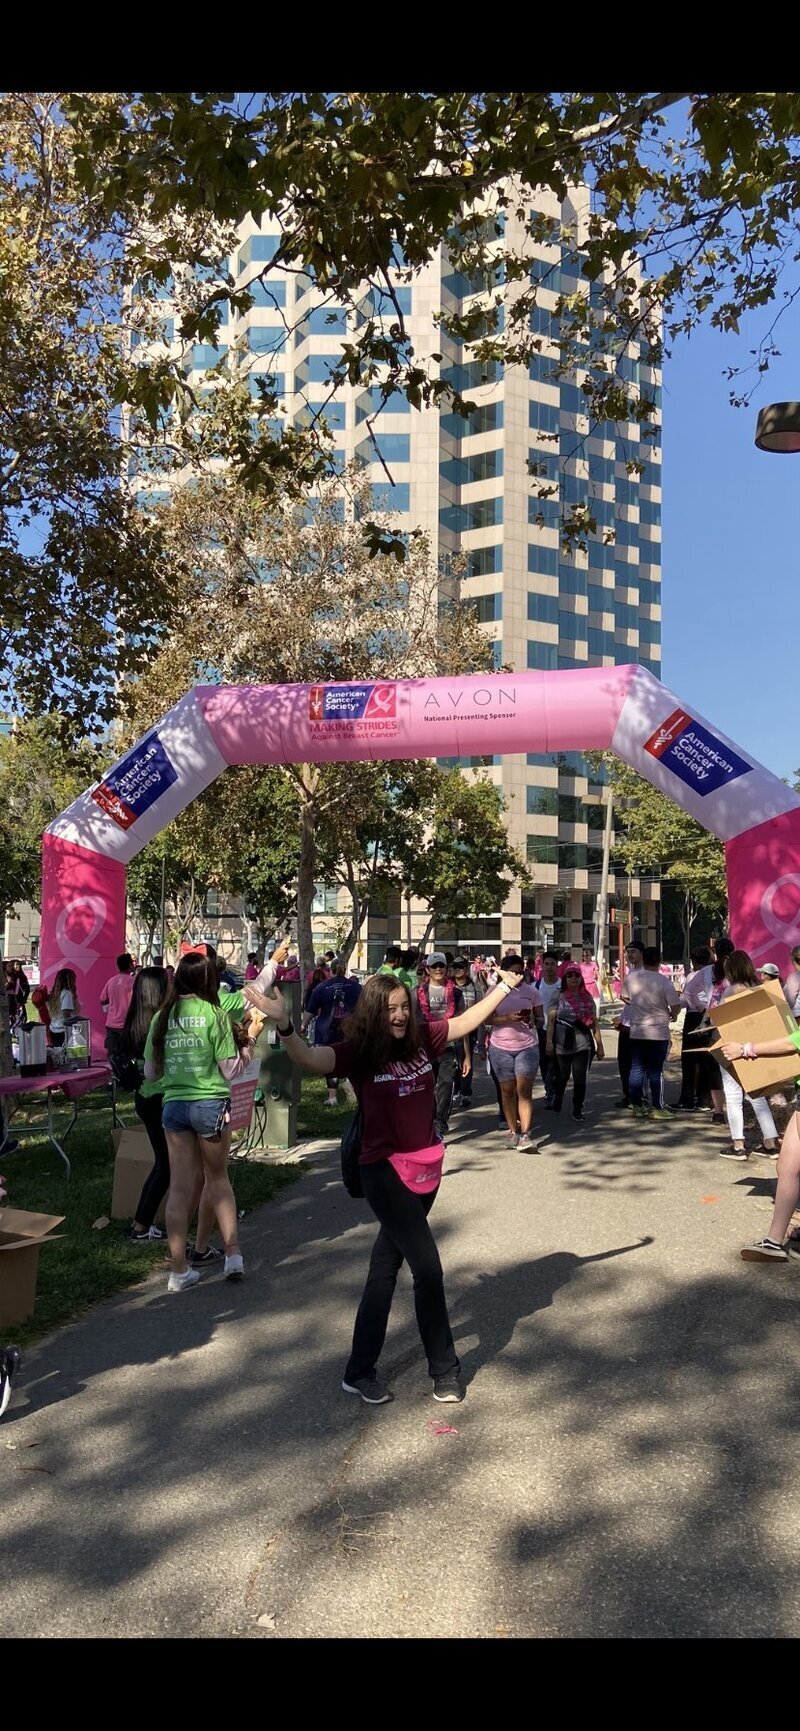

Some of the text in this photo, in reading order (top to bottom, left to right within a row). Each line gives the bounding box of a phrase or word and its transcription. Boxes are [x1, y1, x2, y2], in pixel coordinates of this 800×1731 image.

[424, 688, 516, 708] AVON
[310, 721, 397, 732] MAKING STRIDES
[453, 713, 488, 721] Presenting
[671, 745, 709, 780] Society
[679, 738, 715, 769] Cancer
[685, 732, 734, 773] American
[114, 748, 157, 790] American
[120, 765, 152, 796] Cancer
[126, 770, 161, 804] Society
[168, 1016, 206, 1030] LUNTEER
